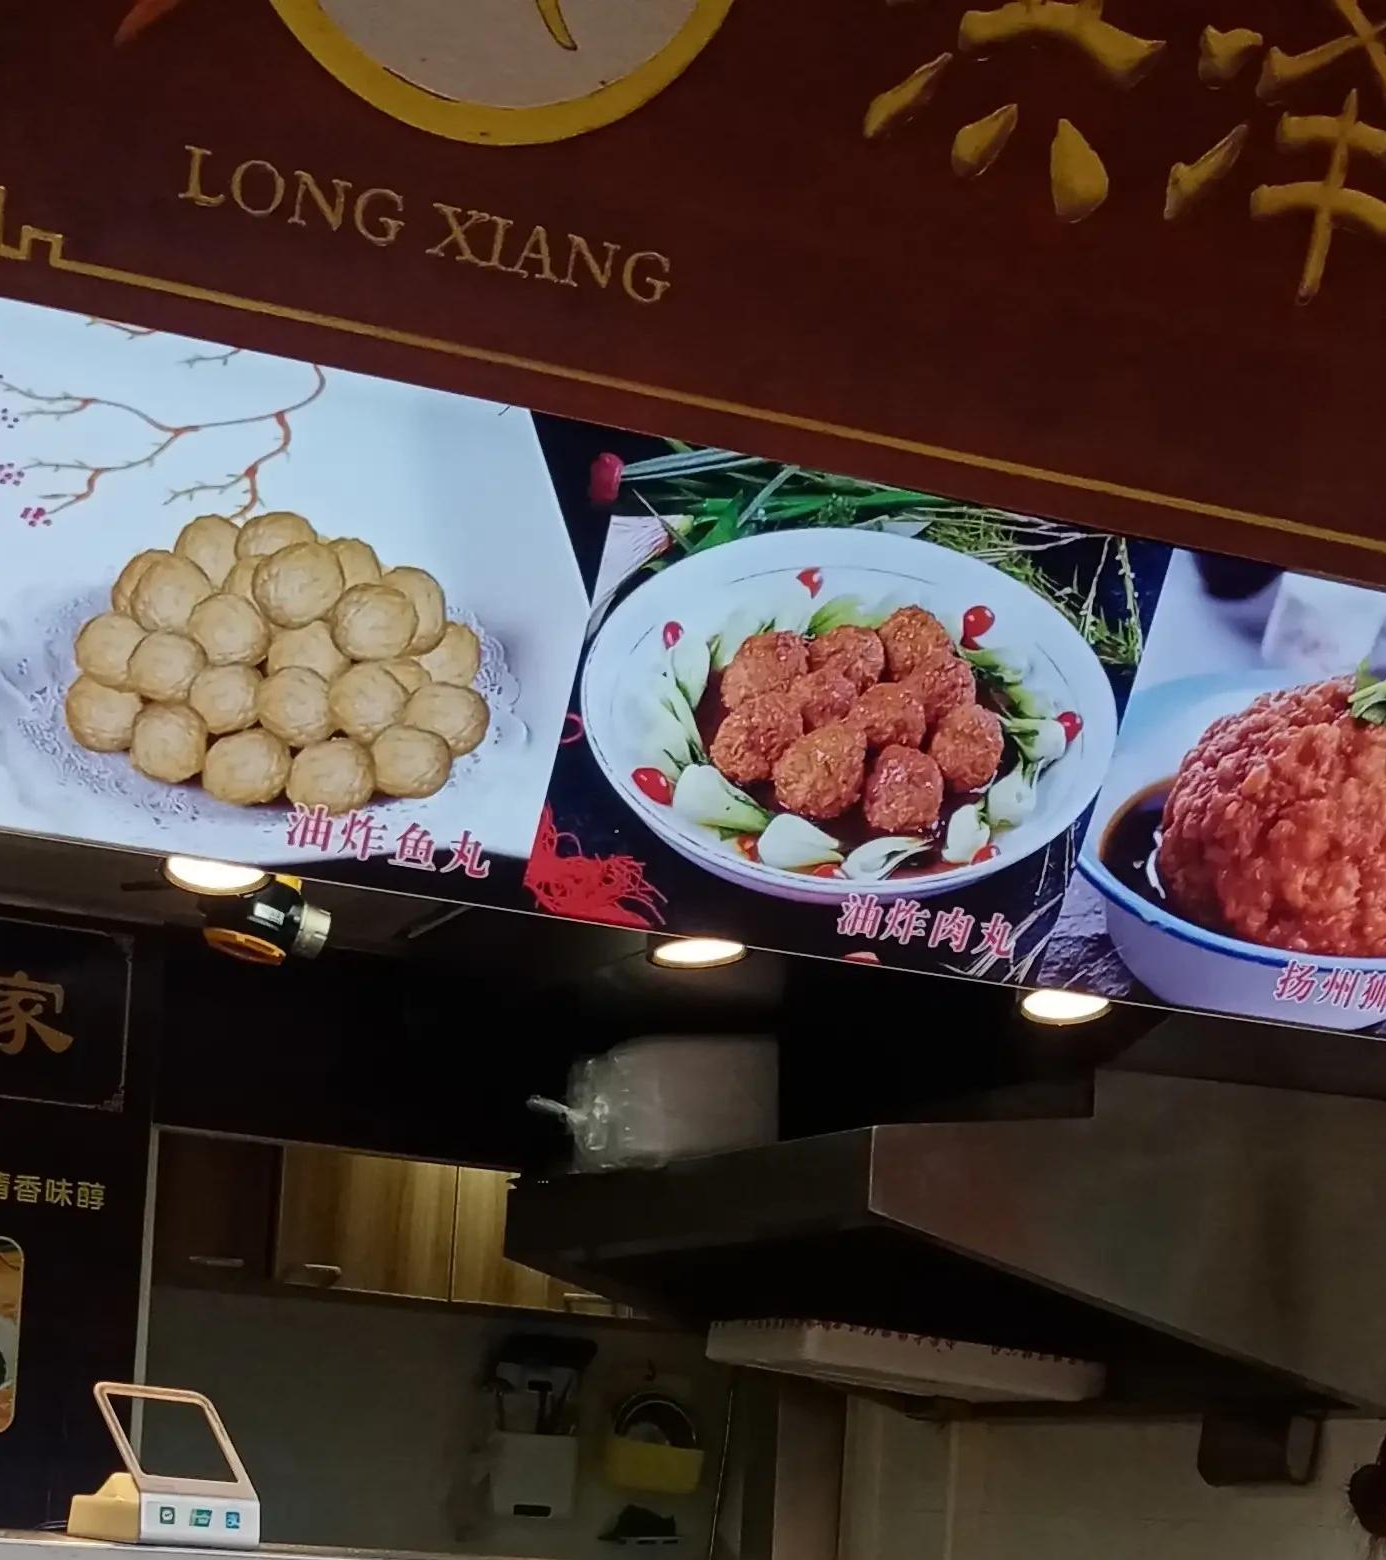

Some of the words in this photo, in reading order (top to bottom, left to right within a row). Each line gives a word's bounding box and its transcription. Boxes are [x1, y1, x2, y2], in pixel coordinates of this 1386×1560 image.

[177, 144, 406, 248] LONG
[424, 202, 672, 303] XIANG
[285, 801, 491, 879] 油炸鱼丸
[836, 893, 1017, 960] 油炸肉丸
